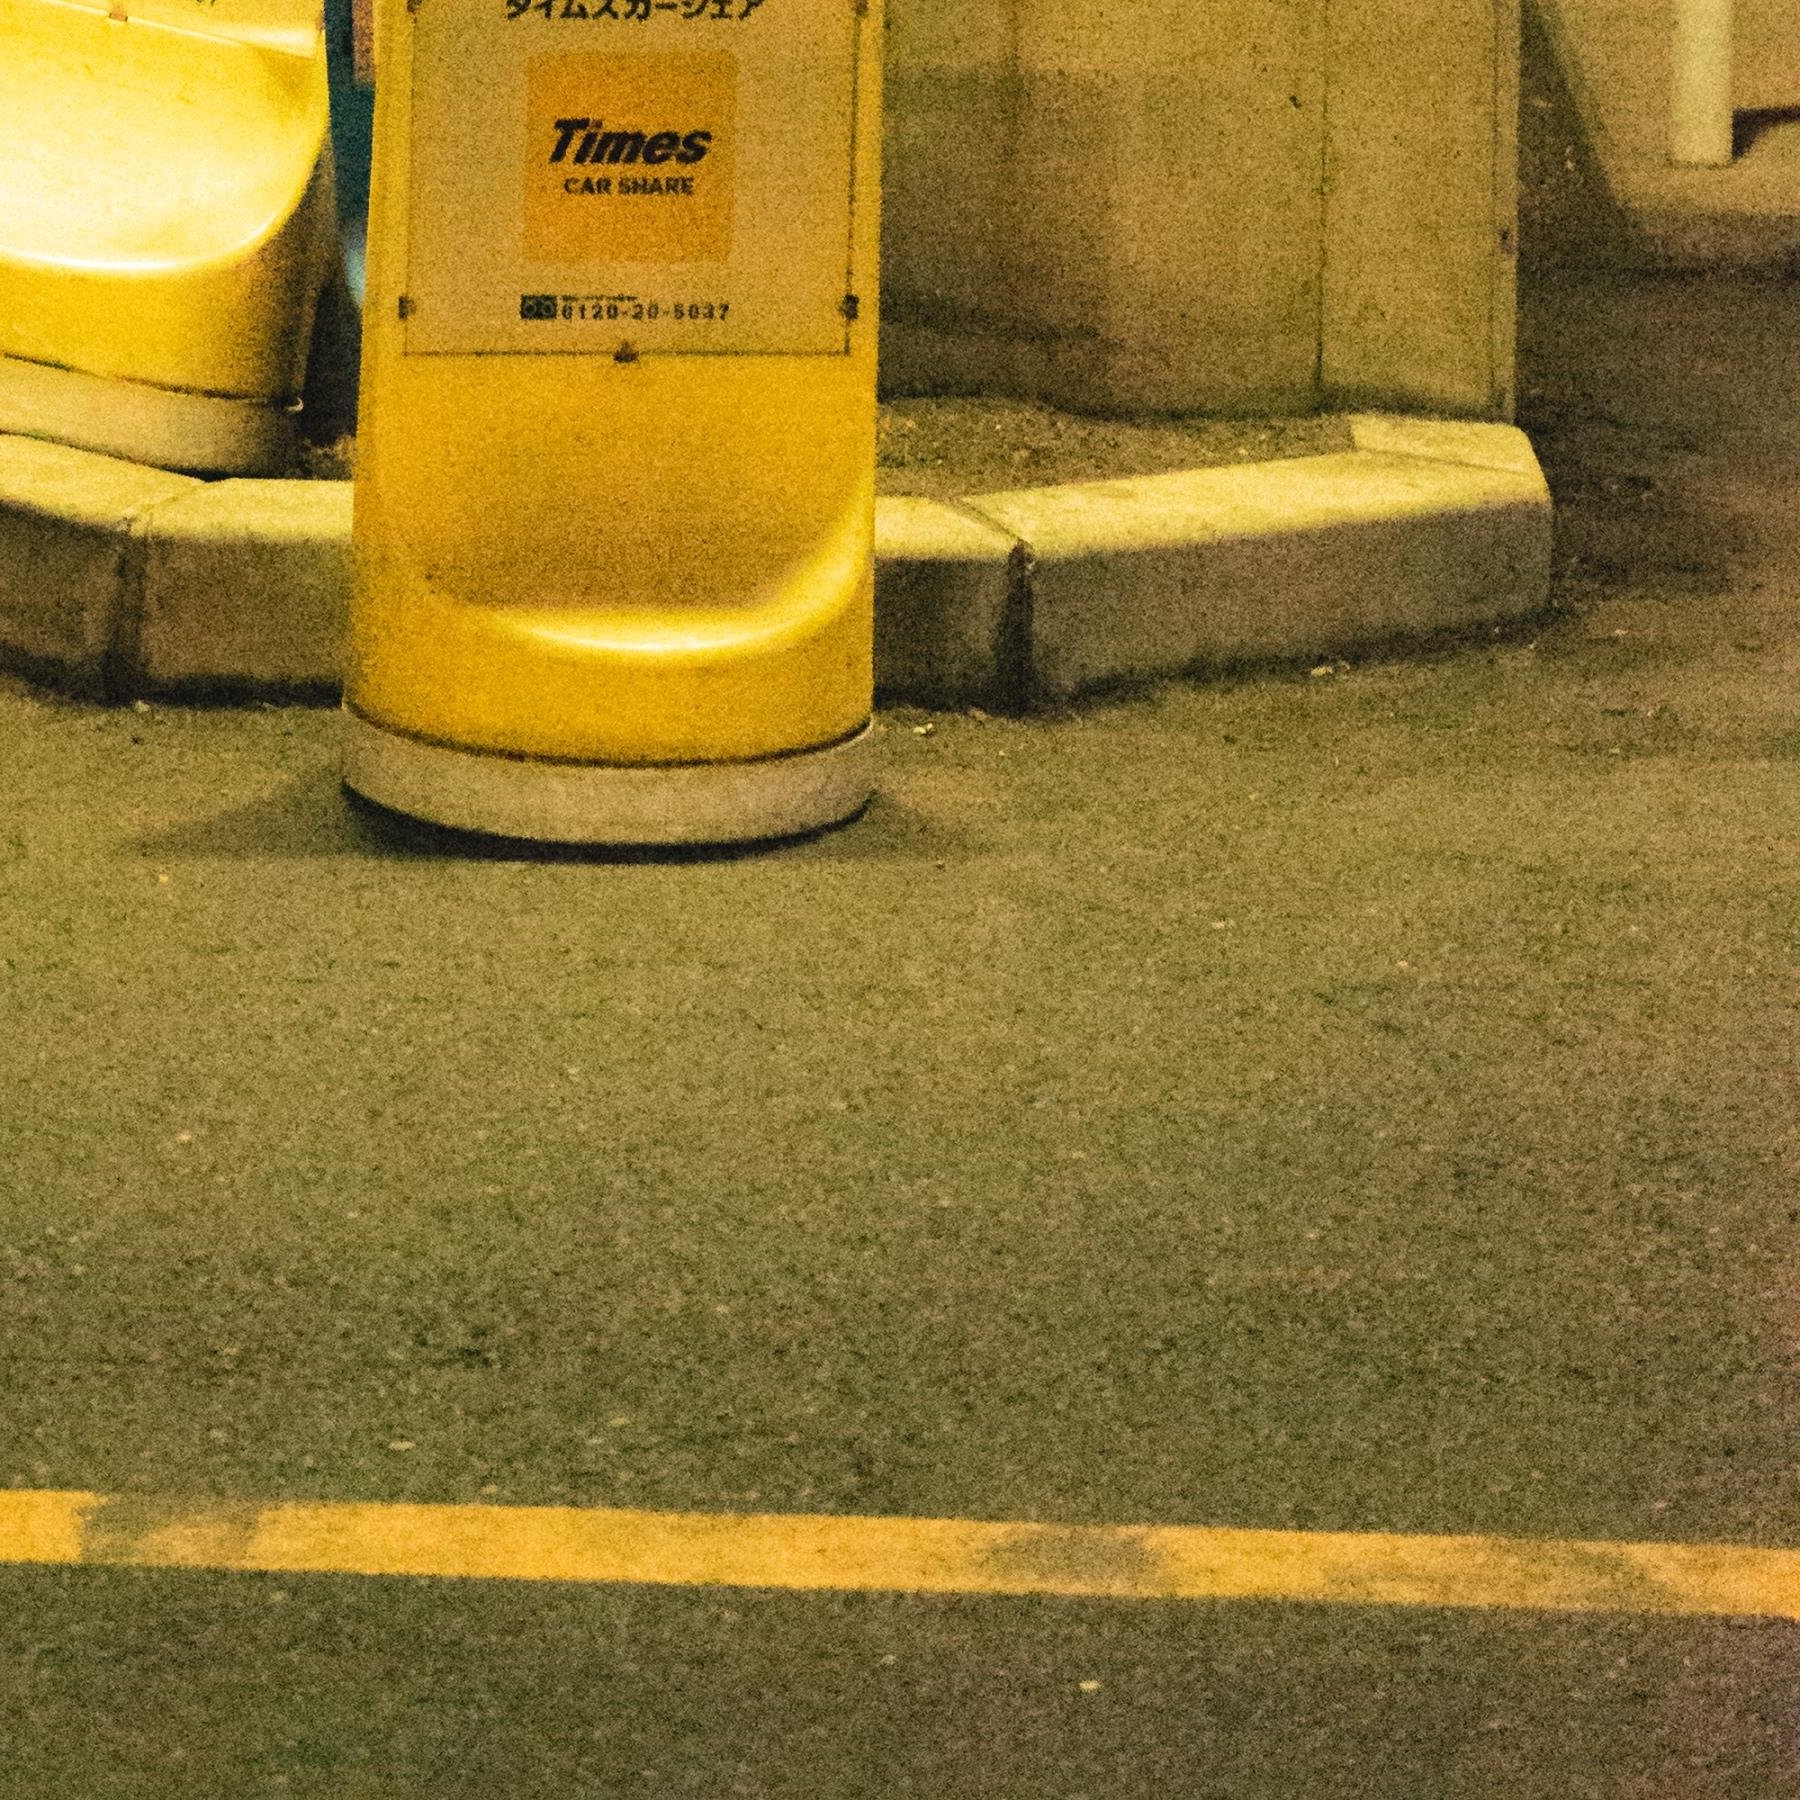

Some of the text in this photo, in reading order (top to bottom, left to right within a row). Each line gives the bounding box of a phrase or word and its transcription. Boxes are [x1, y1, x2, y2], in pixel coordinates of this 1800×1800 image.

[550, 117, 713, 164] Times
[564, 176, 694, 195] CAR SHARE
[561, 303, 730, 321] 0120-20-5037
